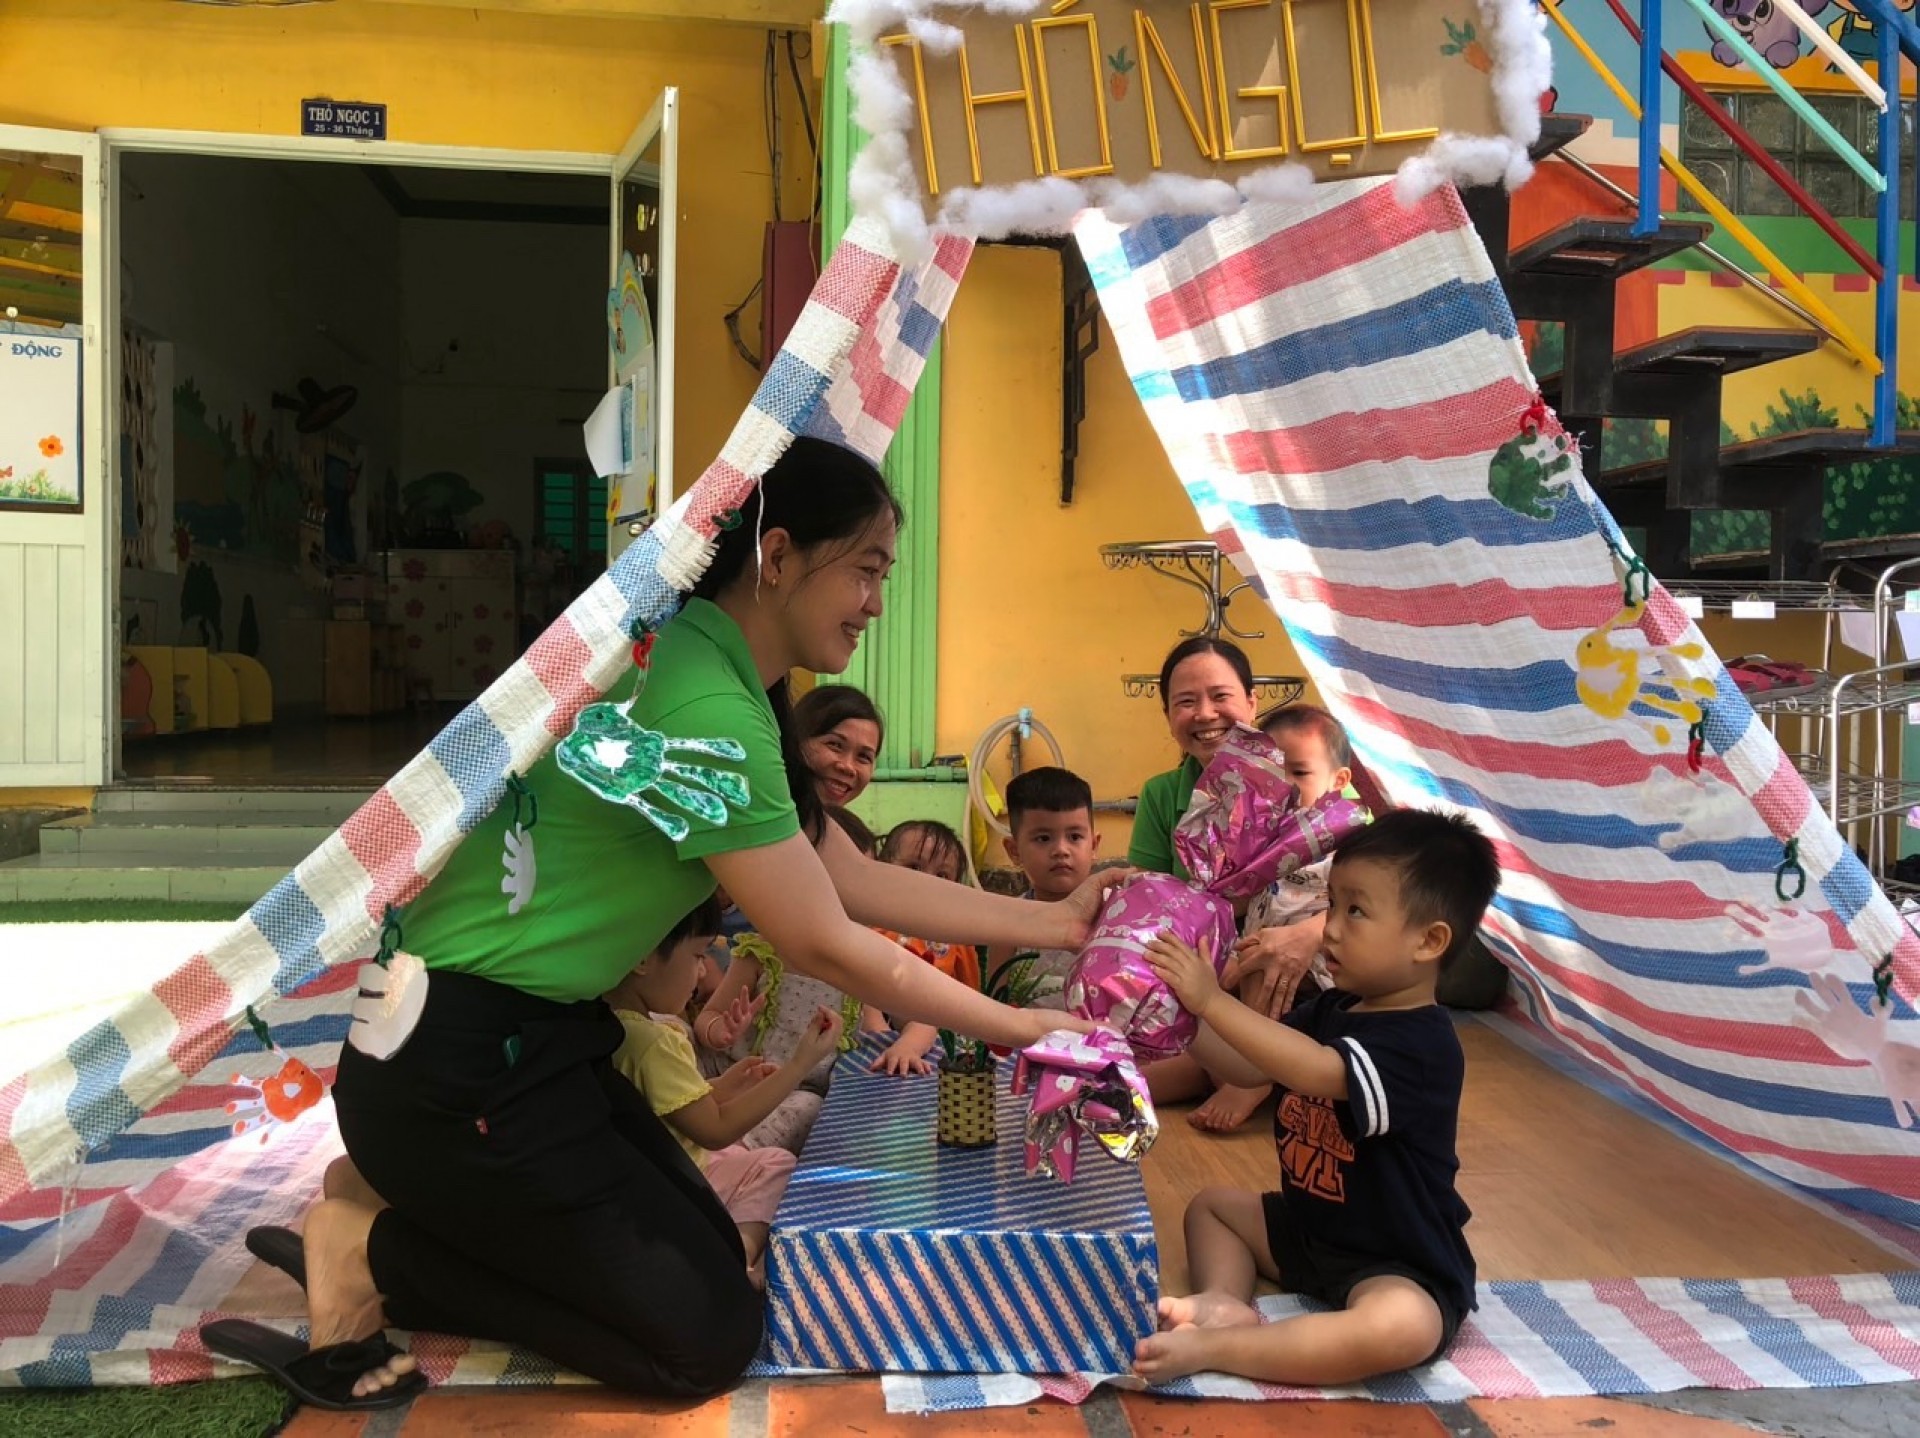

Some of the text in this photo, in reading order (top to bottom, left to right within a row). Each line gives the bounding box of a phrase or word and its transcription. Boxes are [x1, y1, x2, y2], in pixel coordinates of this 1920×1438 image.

[308, 103, 380, 127] THỎ NGỌC 1
[314, 124, 325, 132] 25
[333, 125, 343, 133] 36
[346, 126, 374, 137] Tháng
[11, 340, 62, 359] ĐỘNG
